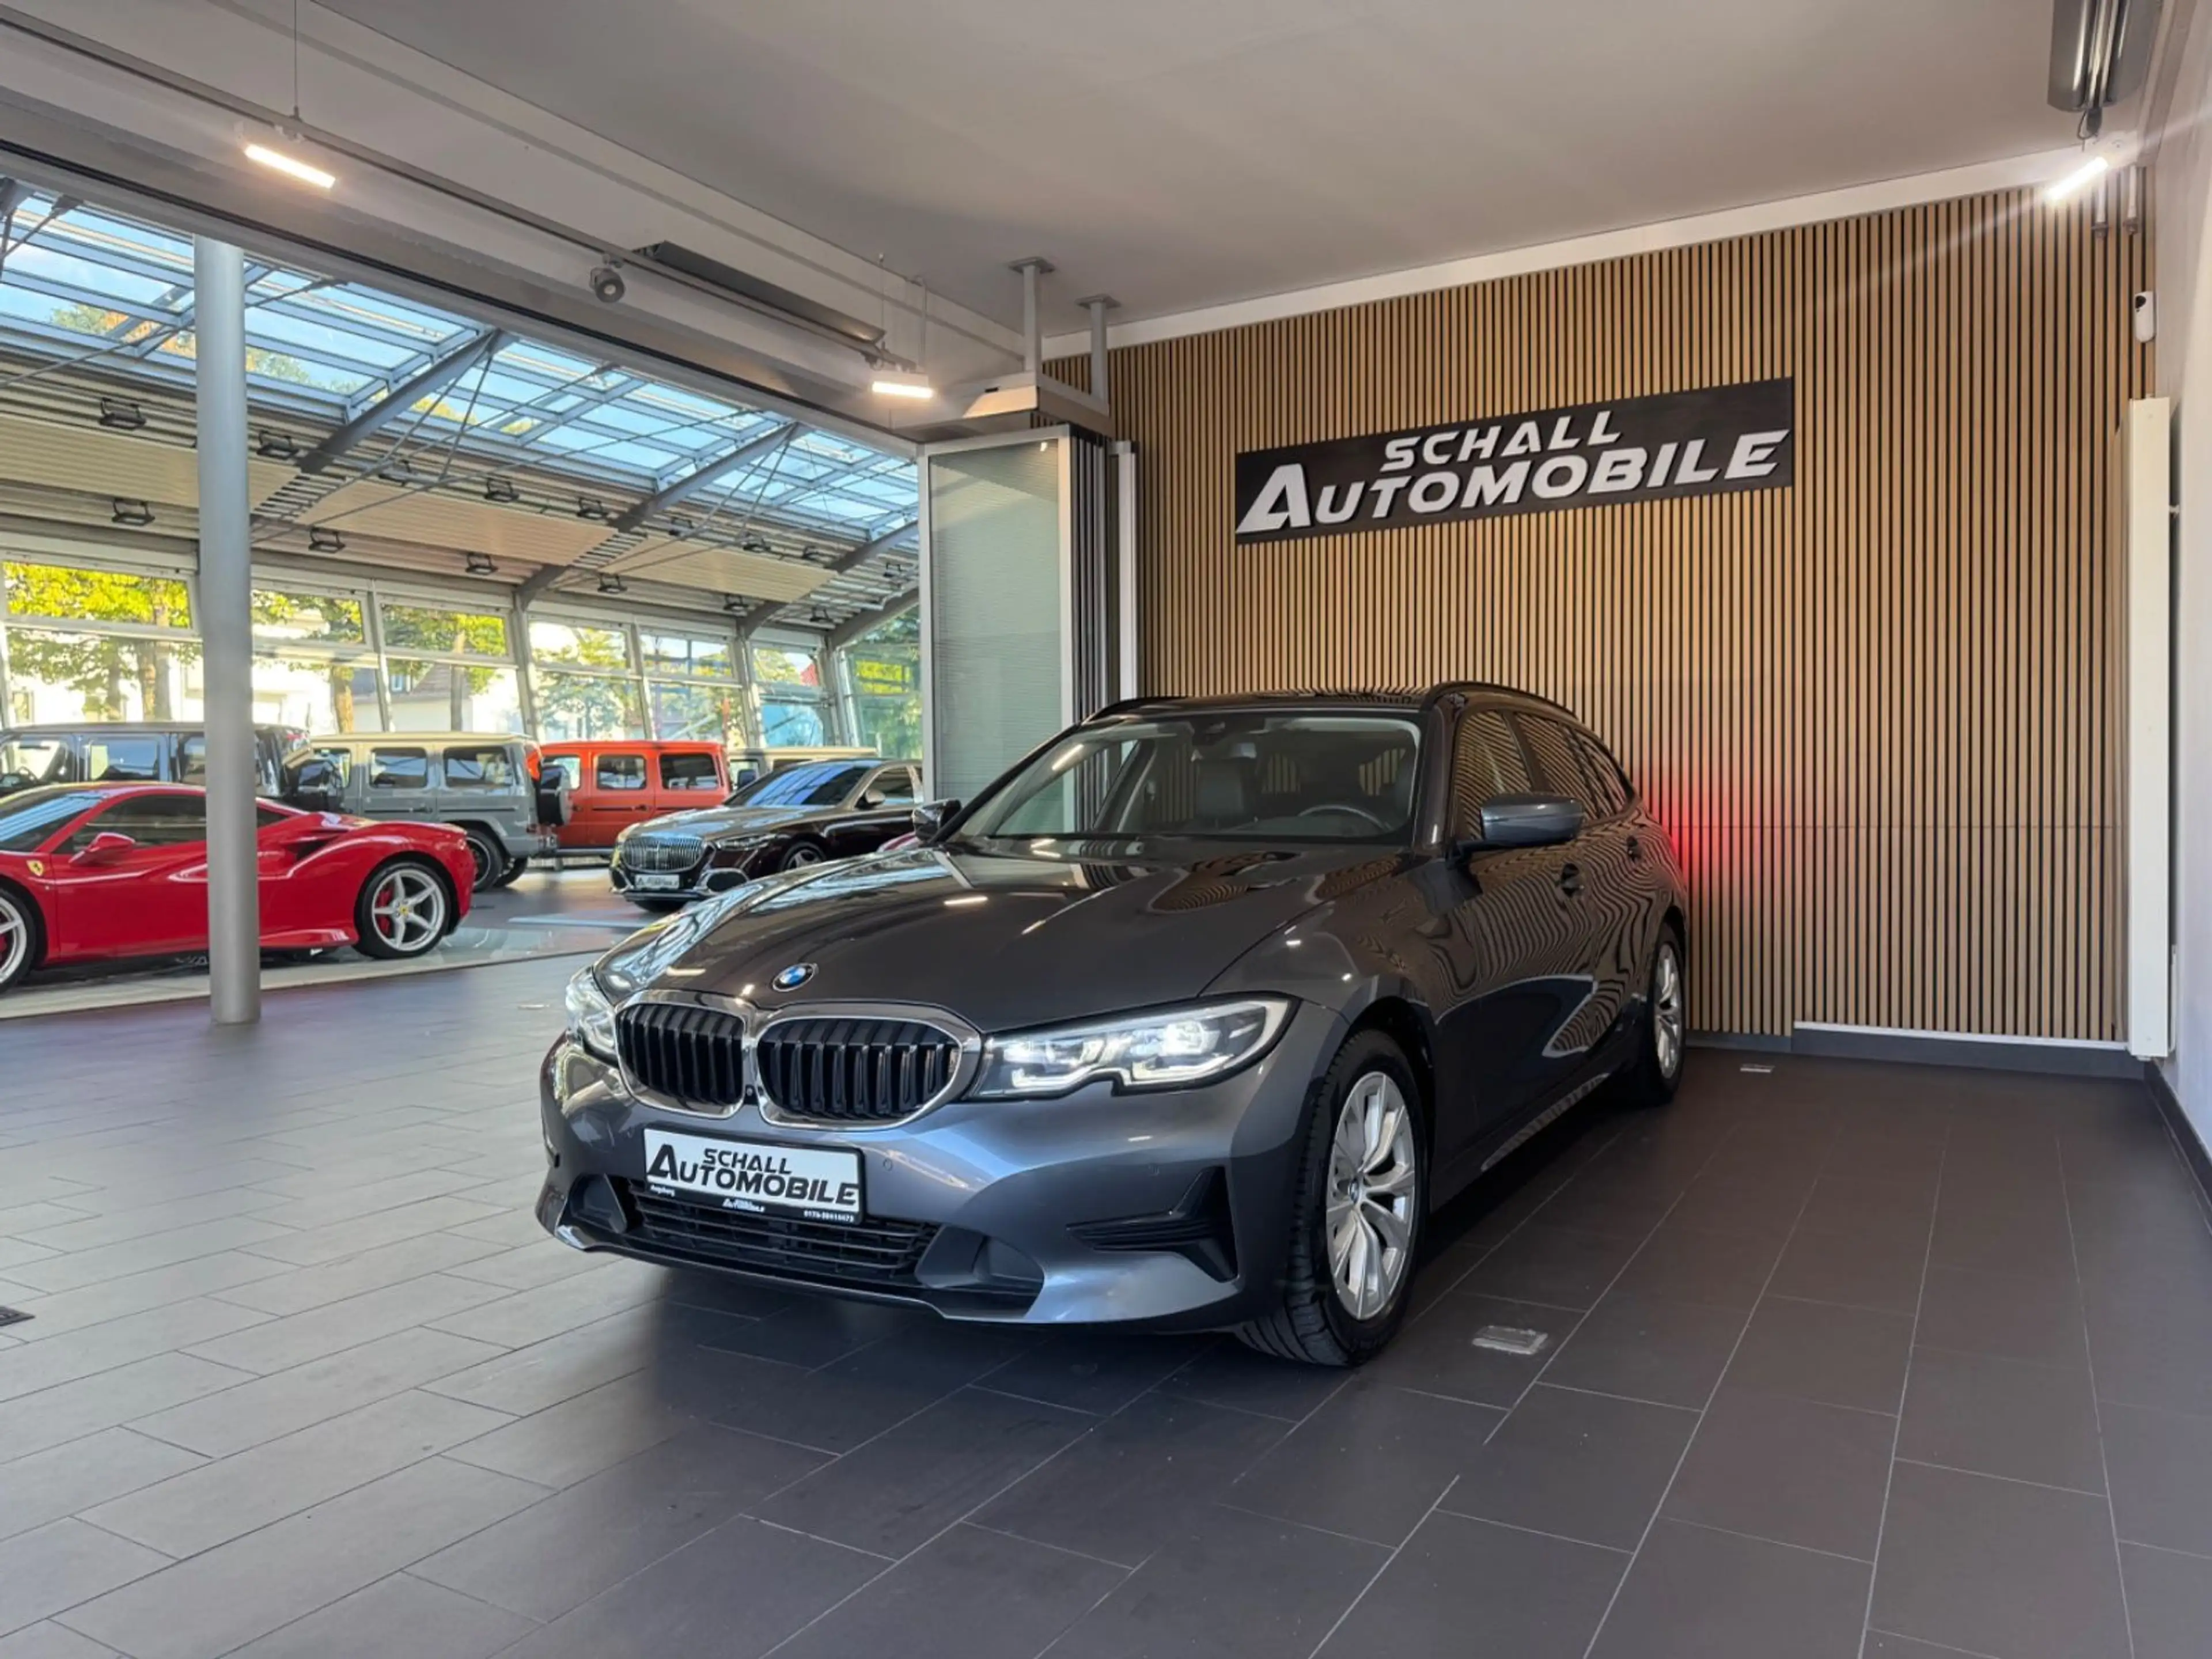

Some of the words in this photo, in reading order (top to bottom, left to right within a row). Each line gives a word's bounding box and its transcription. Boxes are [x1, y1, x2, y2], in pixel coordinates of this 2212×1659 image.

[1380, 411, 1621, 472] SCHALL
[1236, 429, 1790, 533] AUTOMOBILE
[647, 1144, 859, 1205] AUTOMOBILE
[703, 1149, 792, 1175] SCHALL
